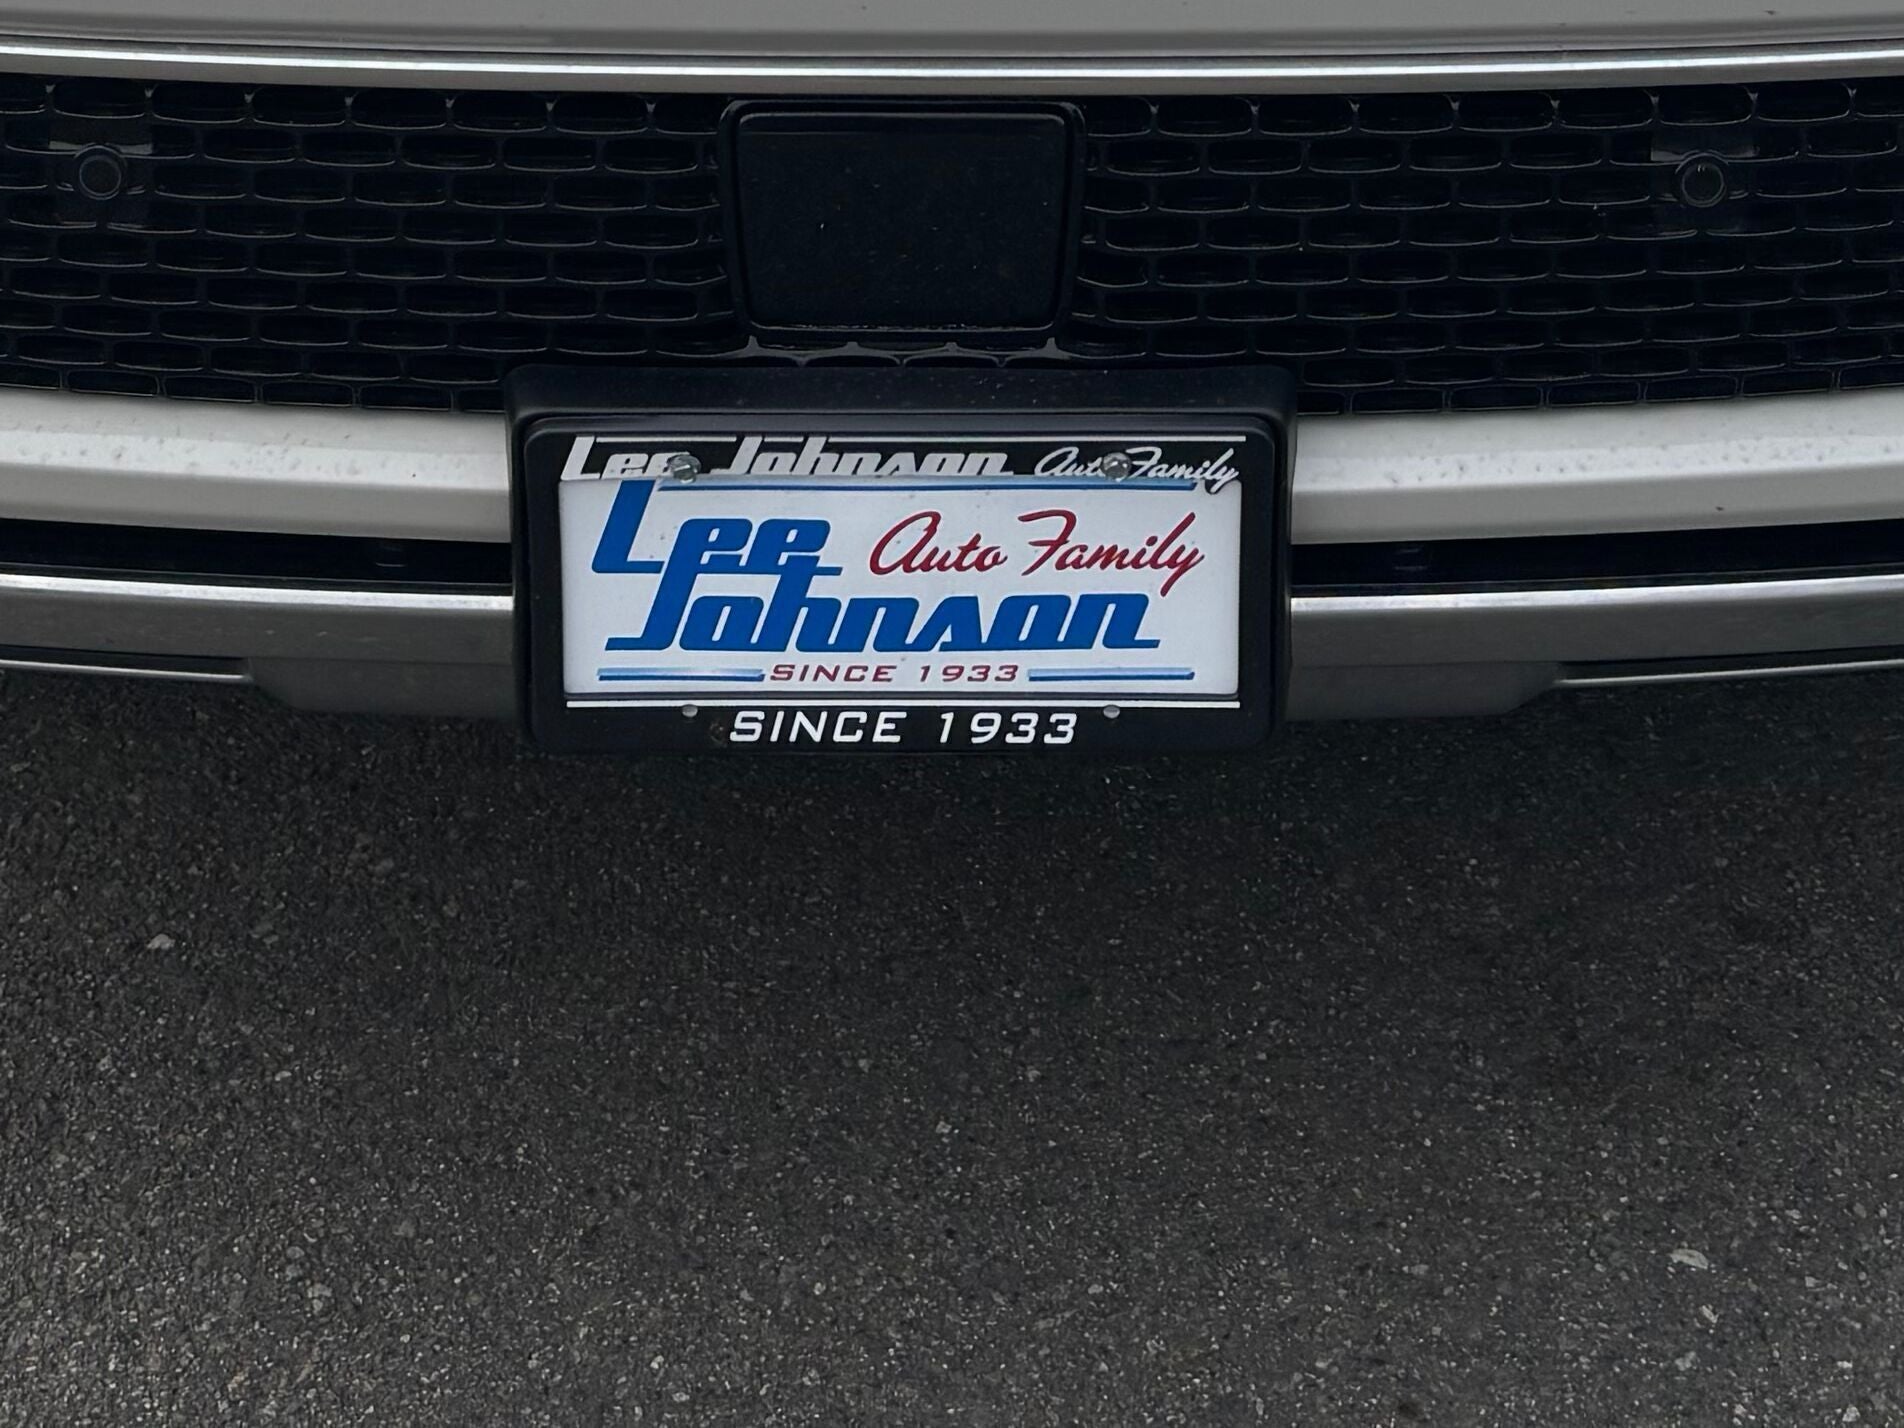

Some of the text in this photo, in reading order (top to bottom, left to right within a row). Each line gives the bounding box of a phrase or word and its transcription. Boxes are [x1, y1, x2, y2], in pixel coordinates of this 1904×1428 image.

[709, 436, 1014, 476] Johnson
[1034, 447, 1110, 477] Aut
[1126, 447, 1240, 494] Family
[592, 480, 1205, 597] Lee Auto Family
[605, 554, 1160, 652] Johnson
[770, 664, 1019, 682] SINCE 1933
[730, 711, 1078, 744] SINCE 1933
